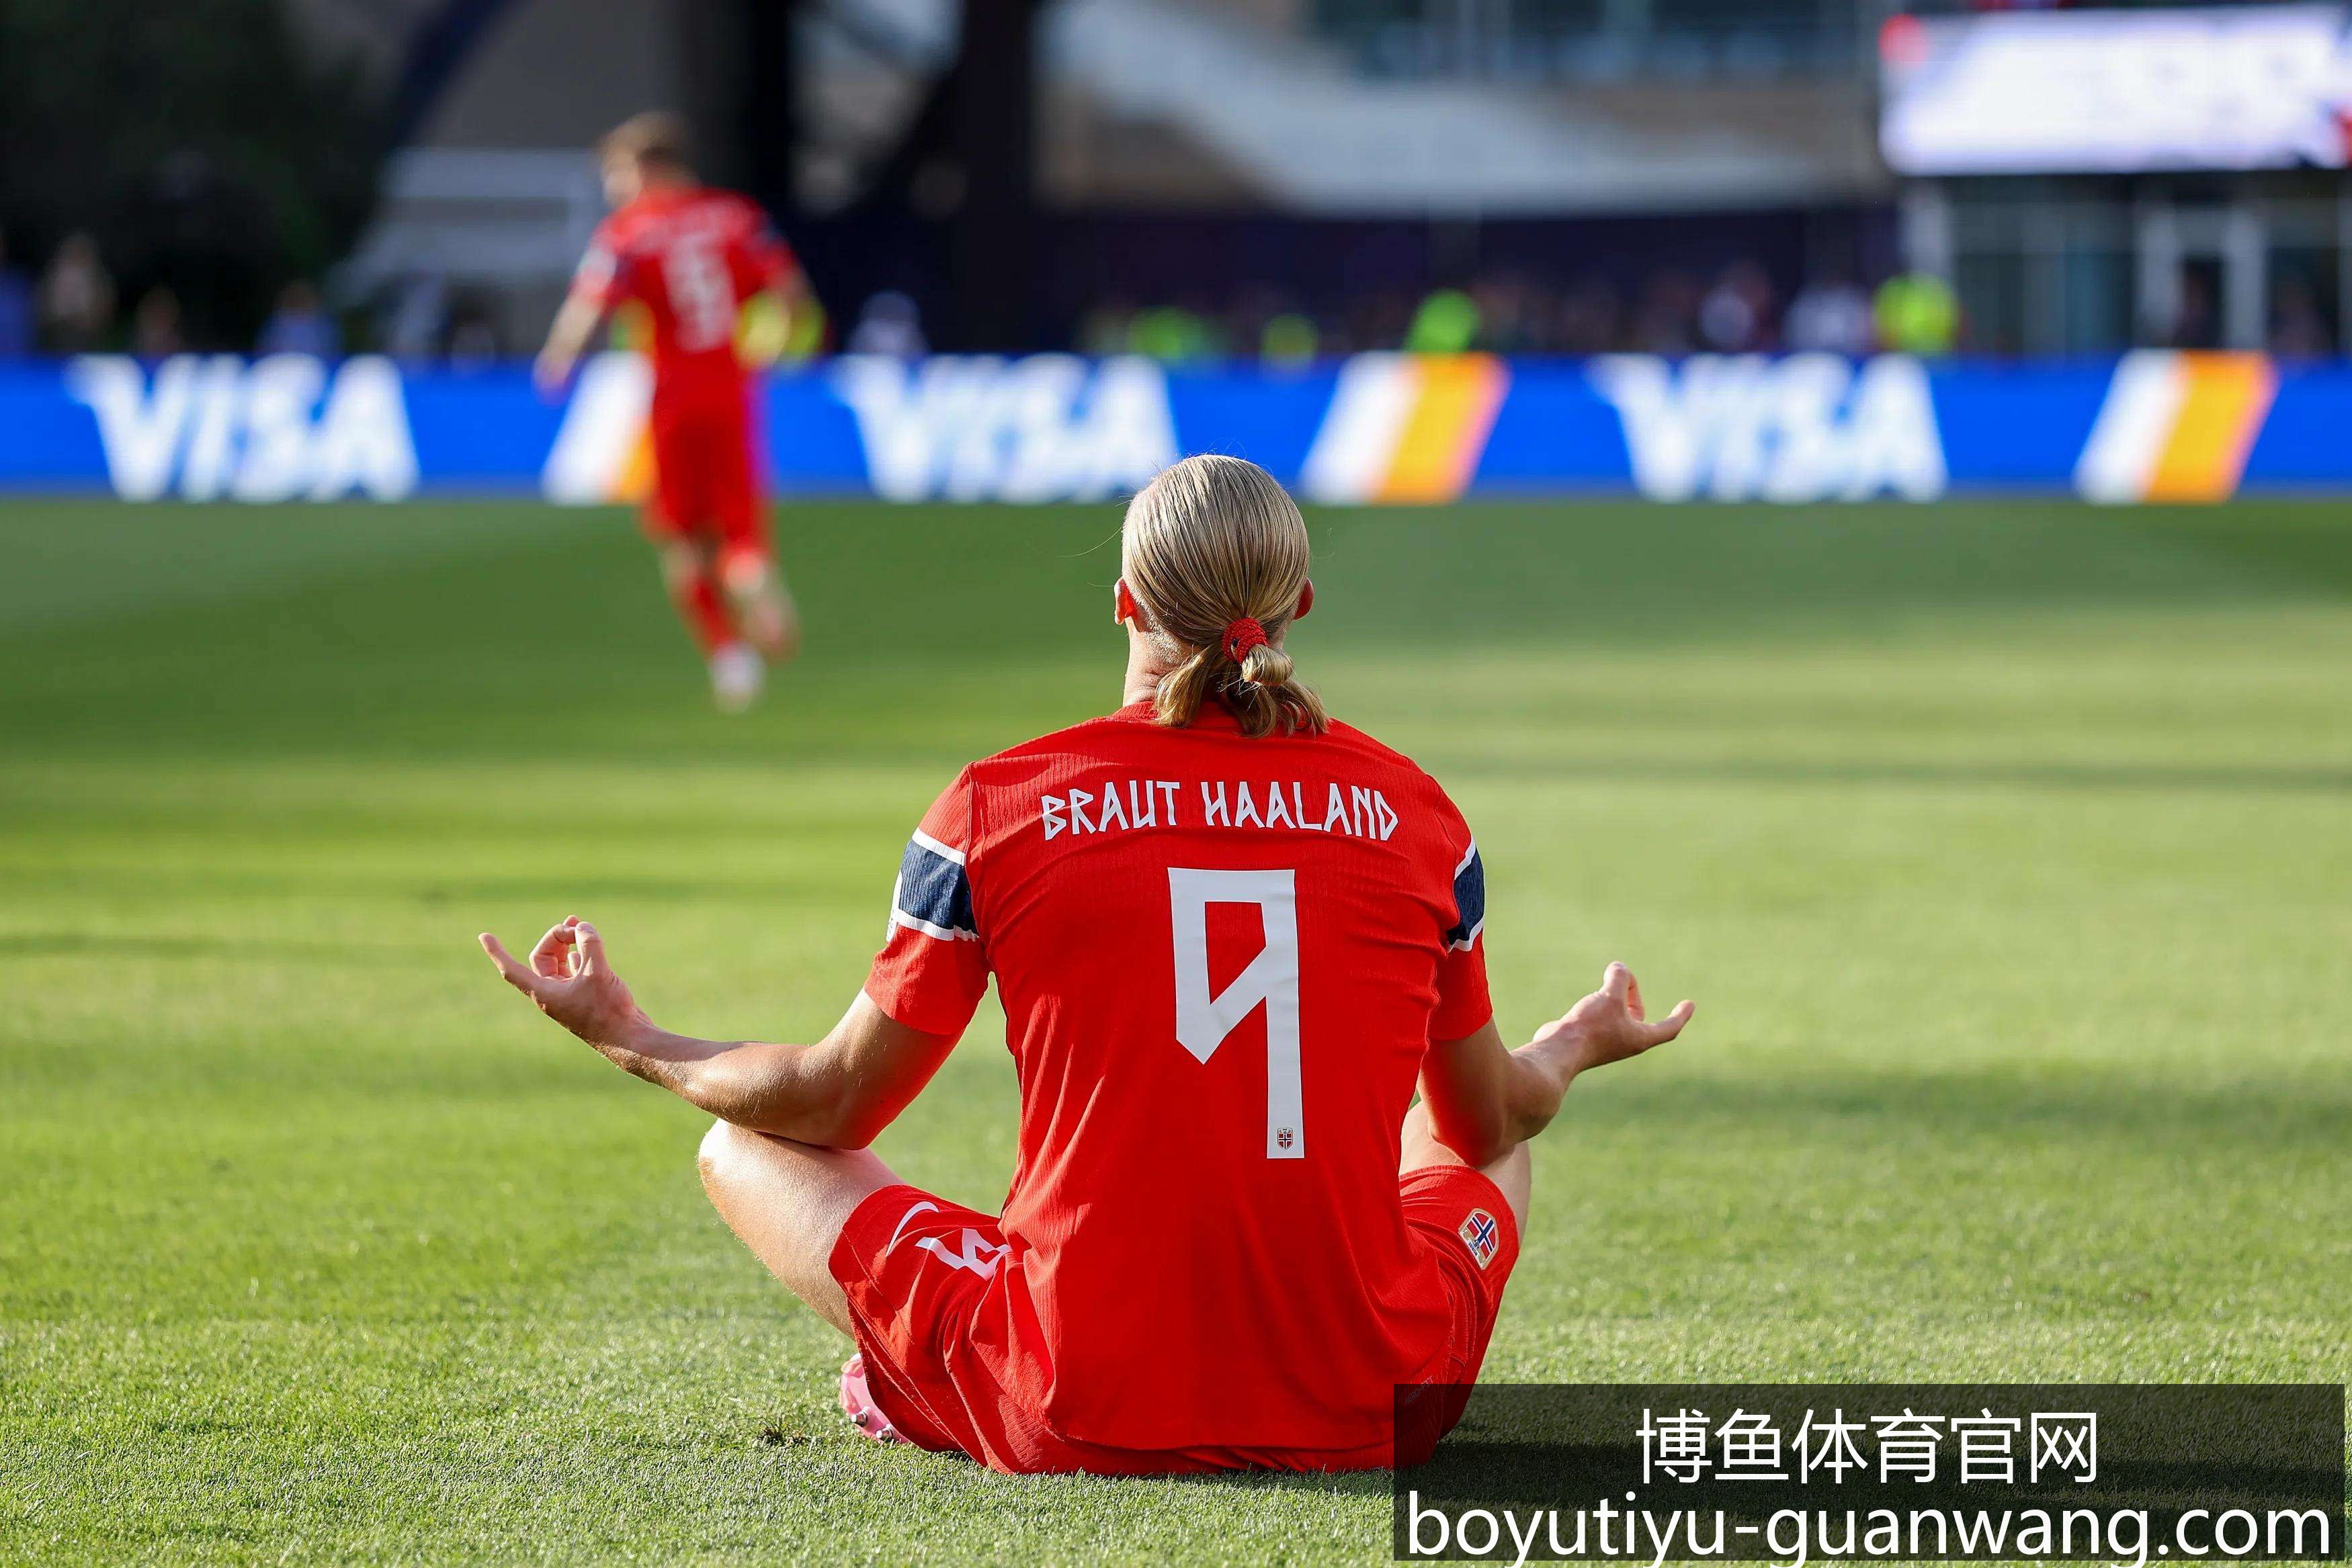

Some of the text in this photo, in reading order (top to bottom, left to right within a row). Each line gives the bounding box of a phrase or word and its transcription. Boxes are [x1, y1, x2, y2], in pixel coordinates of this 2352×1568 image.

[65, 353, 418, 504] VISA
[833, 351, 1179, 504] VISA
[1587, 351, 1947, 504] VISA
[1041, 780, 1398, 841] BRAUT HAALAND
[1167, 867, 1305, 1159] 9
